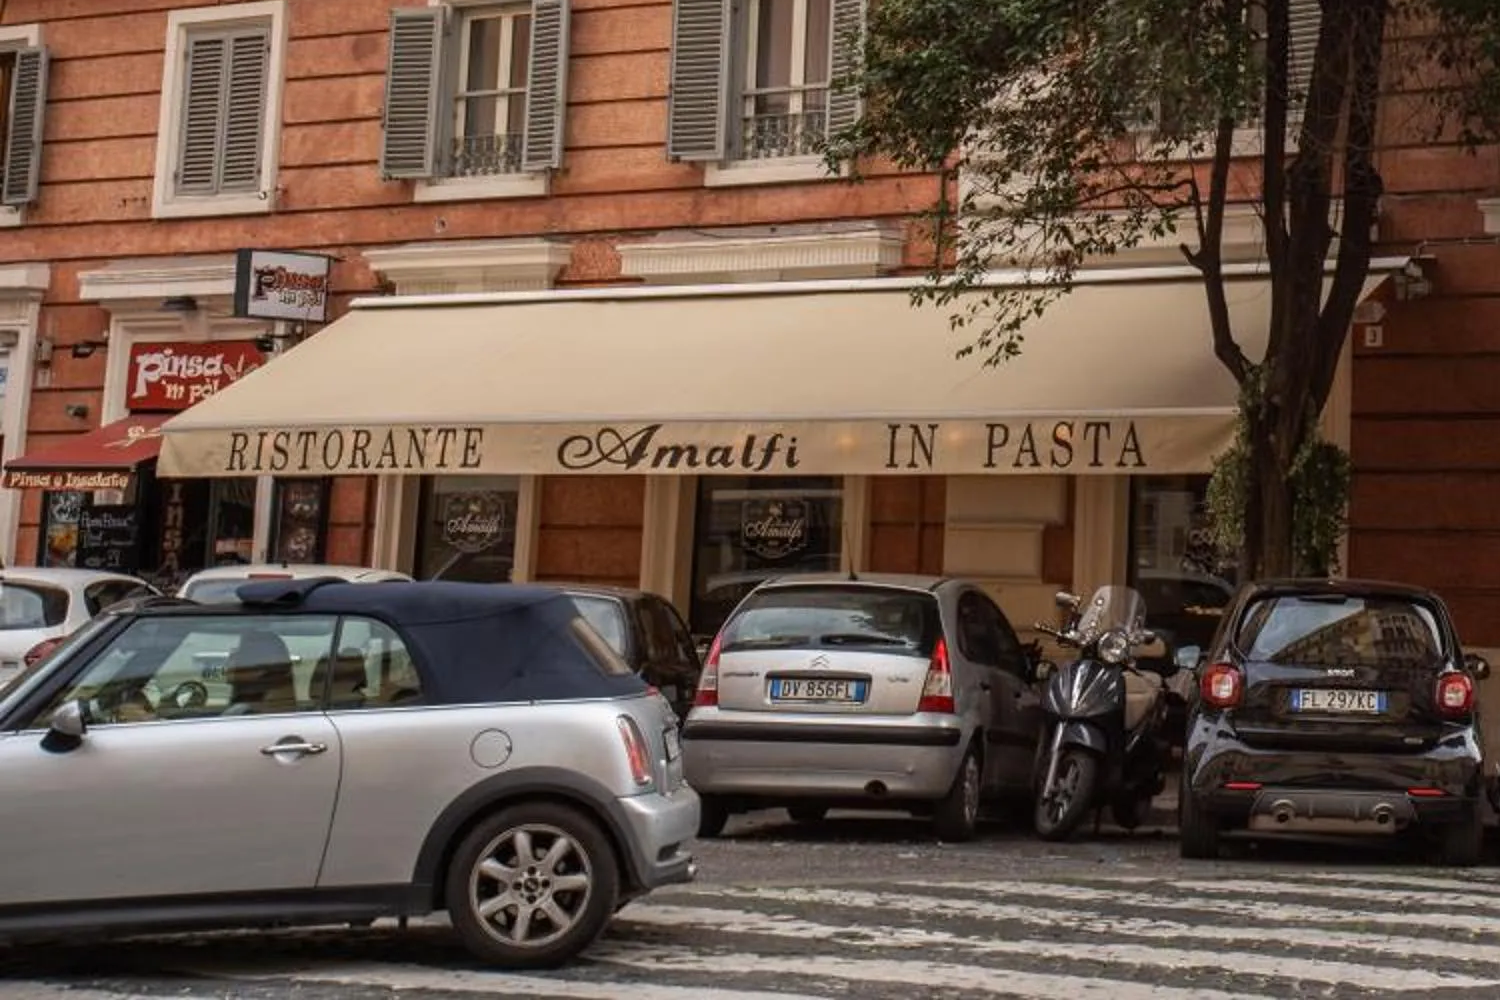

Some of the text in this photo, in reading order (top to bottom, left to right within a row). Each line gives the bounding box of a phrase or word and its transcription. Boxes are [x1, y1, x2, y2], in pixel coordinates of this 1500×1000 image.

[225, 421, 1148, 472] RISTORANTE Amalfi IN PASTA
[781, 680, 852, 699] DV 856FL
[1300, 691, 1376, 710] FL 297KC
